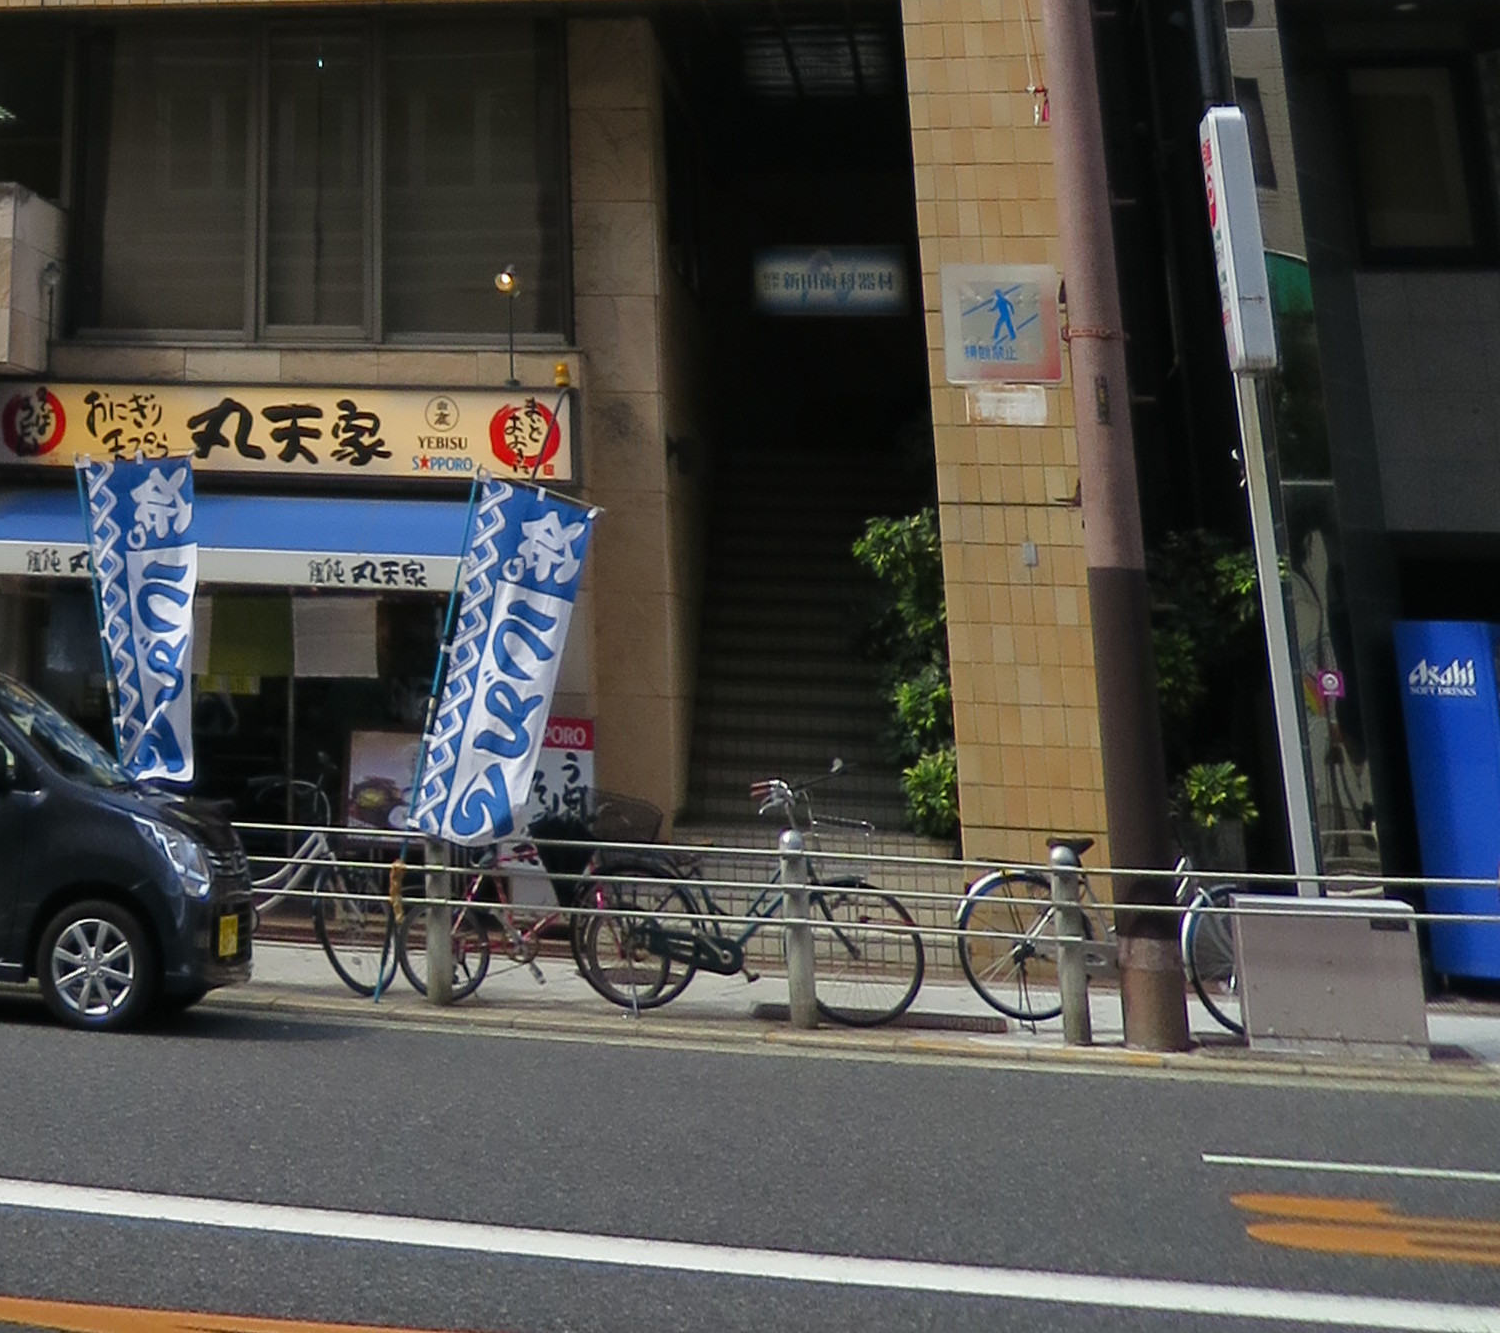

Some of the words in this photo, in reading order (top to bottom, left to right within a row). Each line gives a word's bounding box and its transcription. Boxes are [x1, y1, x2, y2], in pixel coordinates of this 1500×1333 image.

[964, 345, 1018, 361] 横断禁止
[84, 391, 162, 438] おにぎり
[187, 397, 392, 466] 丸天家
[417, 436, 468, 450] YEBISU
[1408, 658, 1475, 686] Asahi
[1438, 687, 1477, 697] DRINKS
